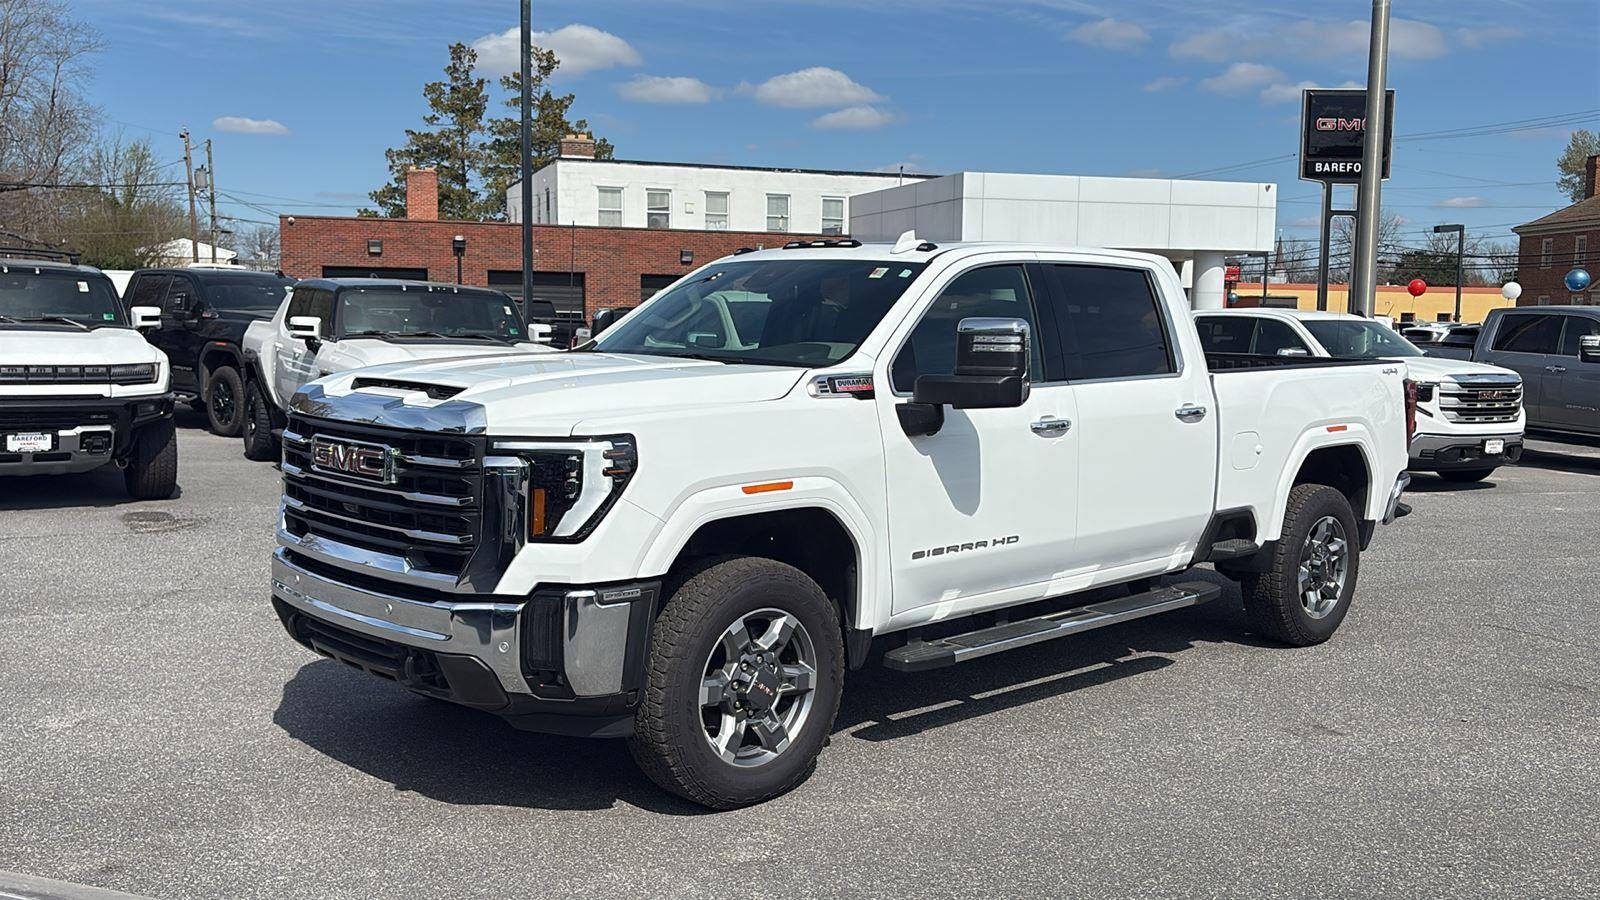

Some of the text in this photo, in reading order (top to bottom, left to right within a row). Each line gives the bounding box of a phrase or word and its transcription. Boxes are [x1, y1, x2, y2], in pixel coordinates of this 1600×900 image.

[1316, 117, 1367, 131] GM
[1315, 162, 1362, 172] BAREFO
[313, 441, 384, 478] GMC
[911, 535, 1019, 560] SIERRA HD
